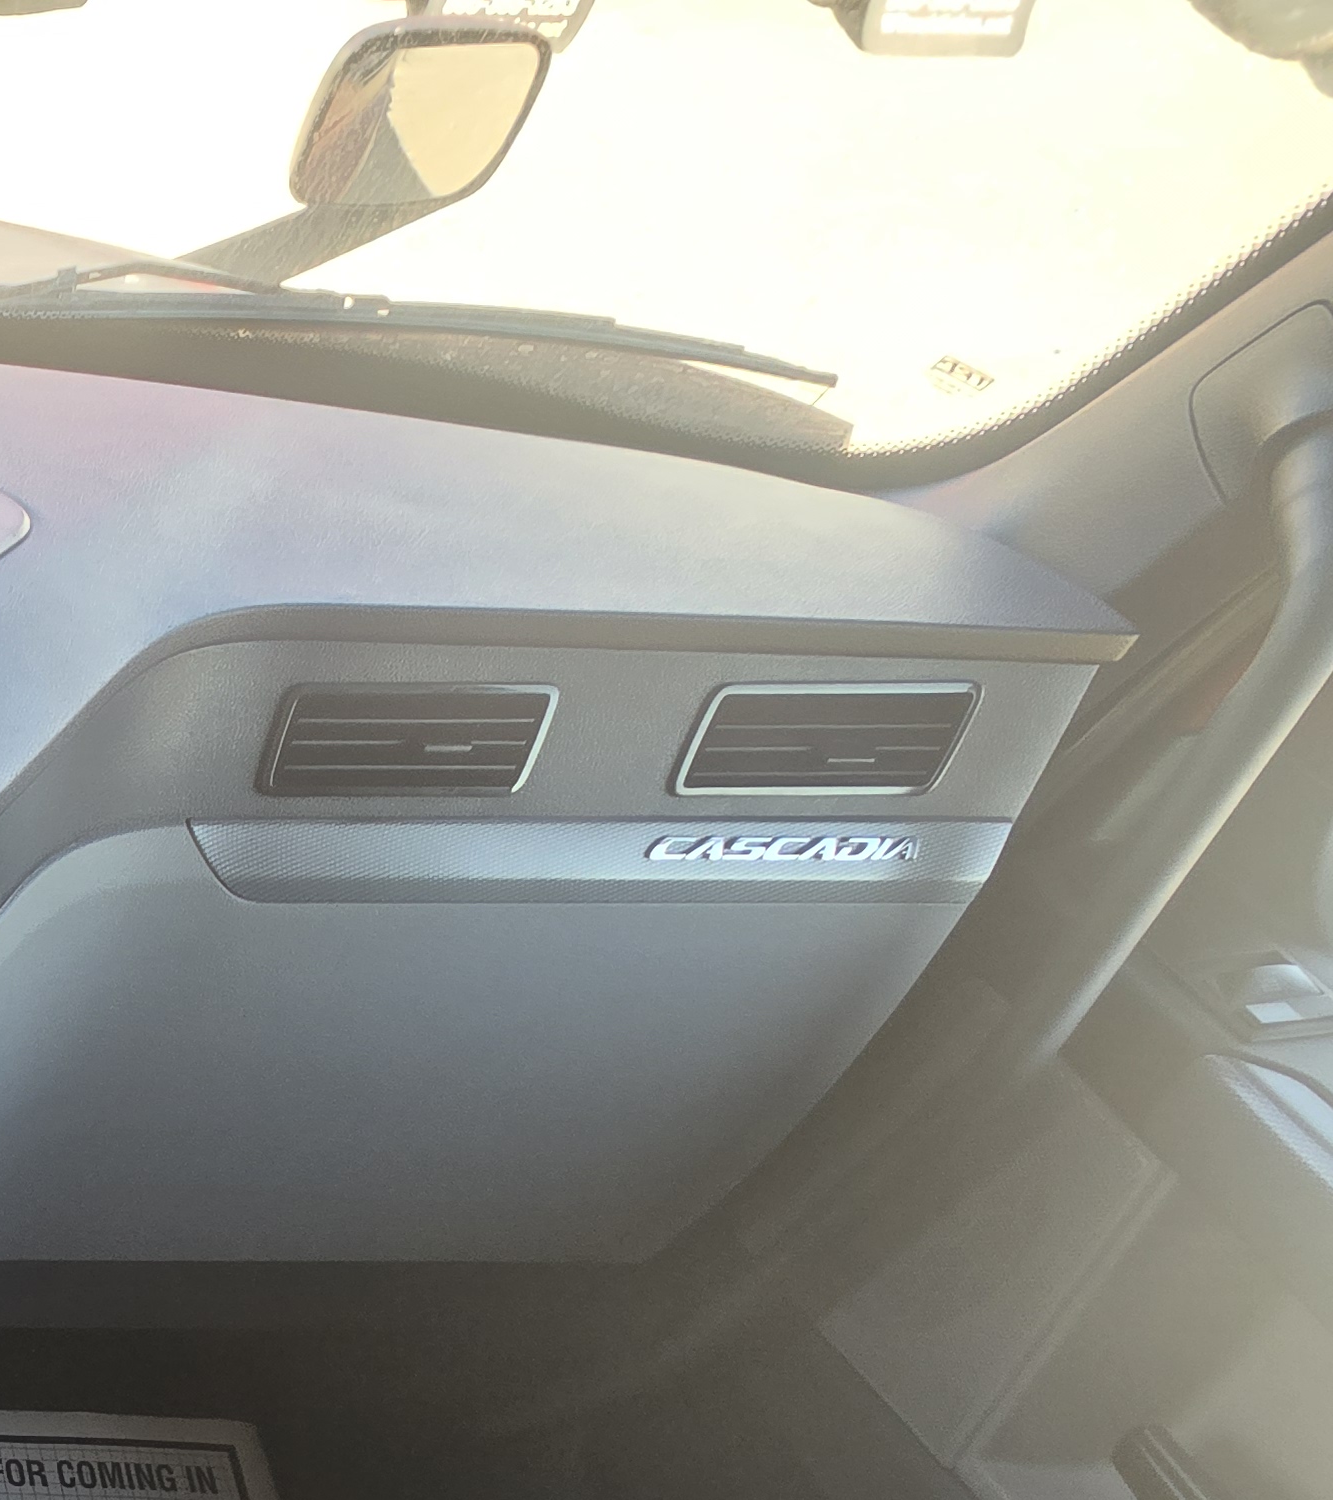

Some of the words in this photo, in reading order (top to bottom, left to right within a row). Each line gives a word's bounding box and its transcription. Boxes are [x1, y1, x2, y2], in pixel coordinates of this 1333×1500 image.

[645, 835, 920, 862] CASCADIA
[56, 1460, 178, 1492] COMING
[185, 1465, 219, 1494] IN
